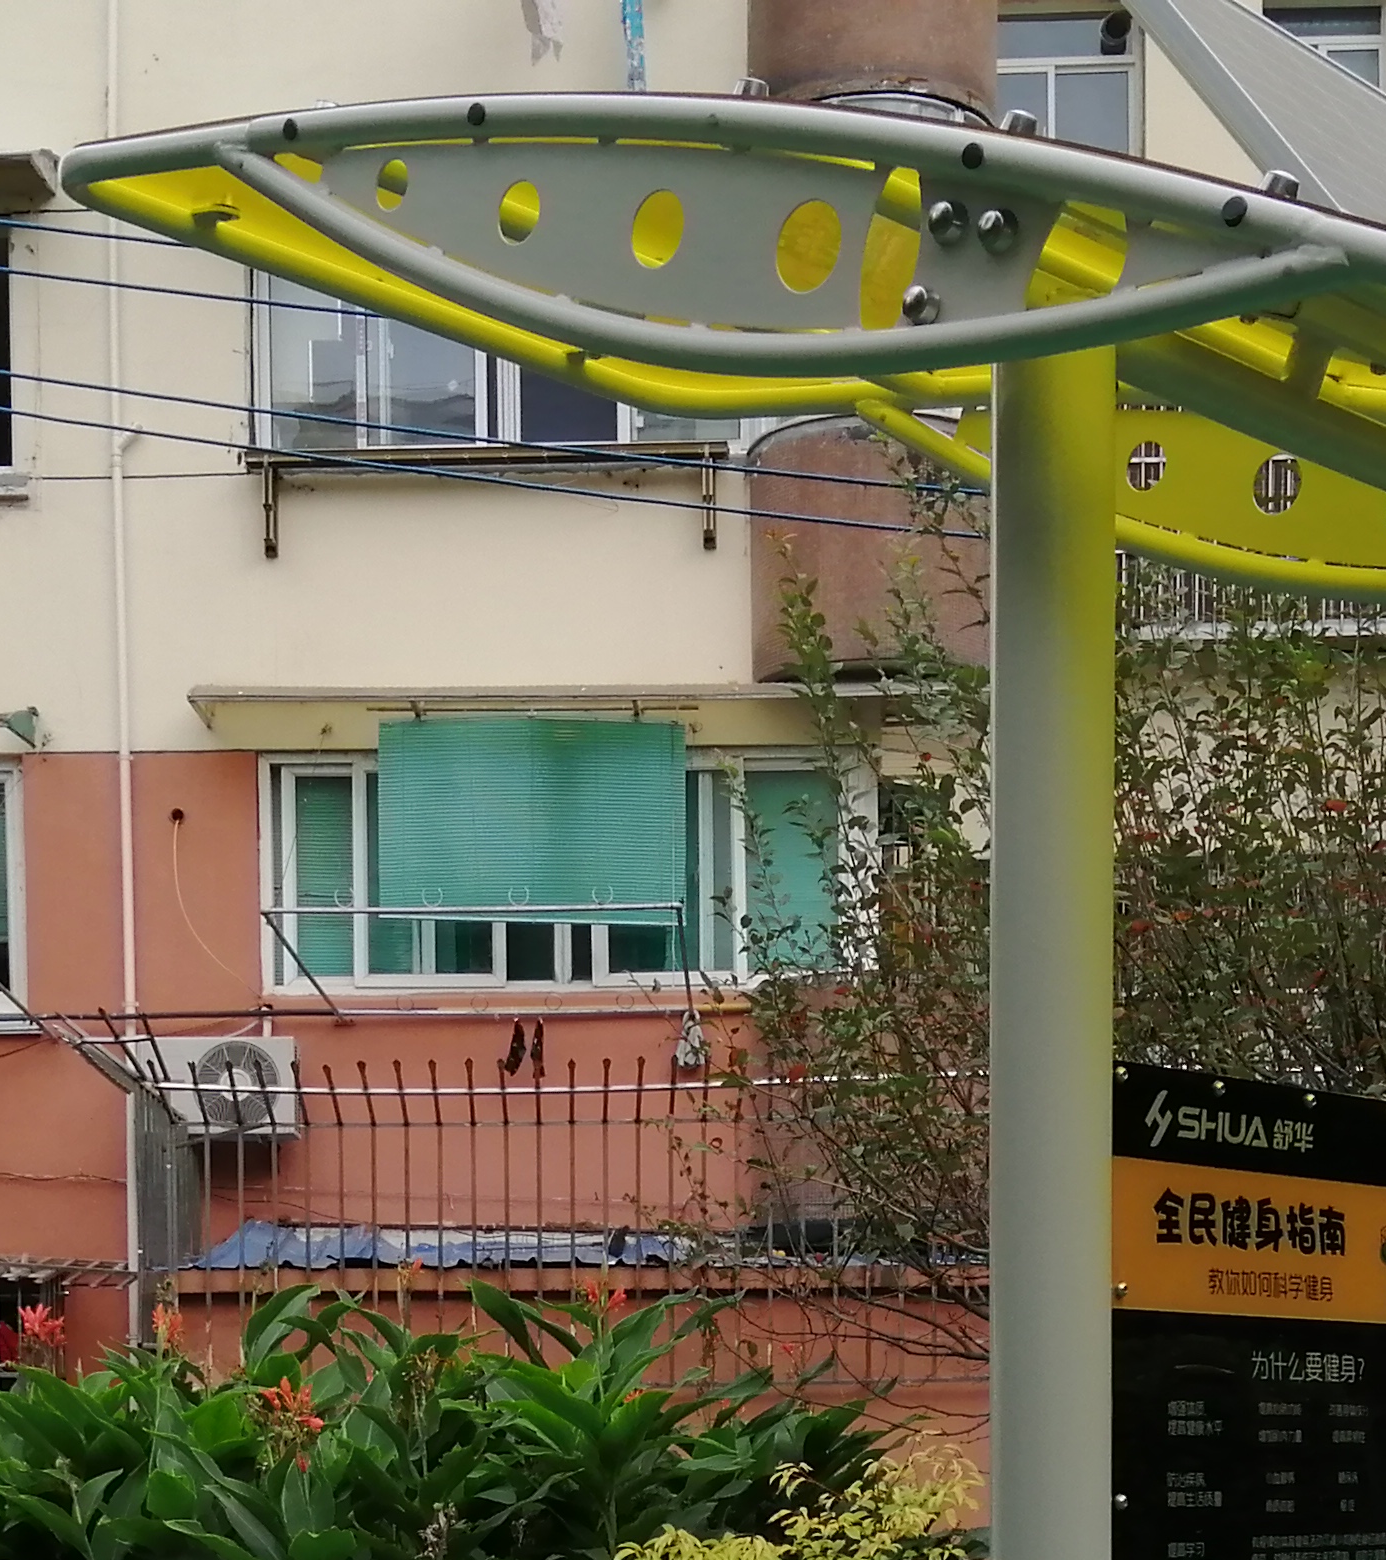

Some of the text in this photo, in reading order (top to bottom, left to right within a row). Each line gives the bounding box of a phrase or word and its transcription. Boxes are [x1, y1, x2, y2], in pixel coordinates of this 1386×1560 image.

[1177, 1106, 1314, 1153] SHUA 舒华
[1153, 1187, 1347, 1257] 全民健身指南
[1208, 1268, 1333, 1302] 教你如何科学健身
